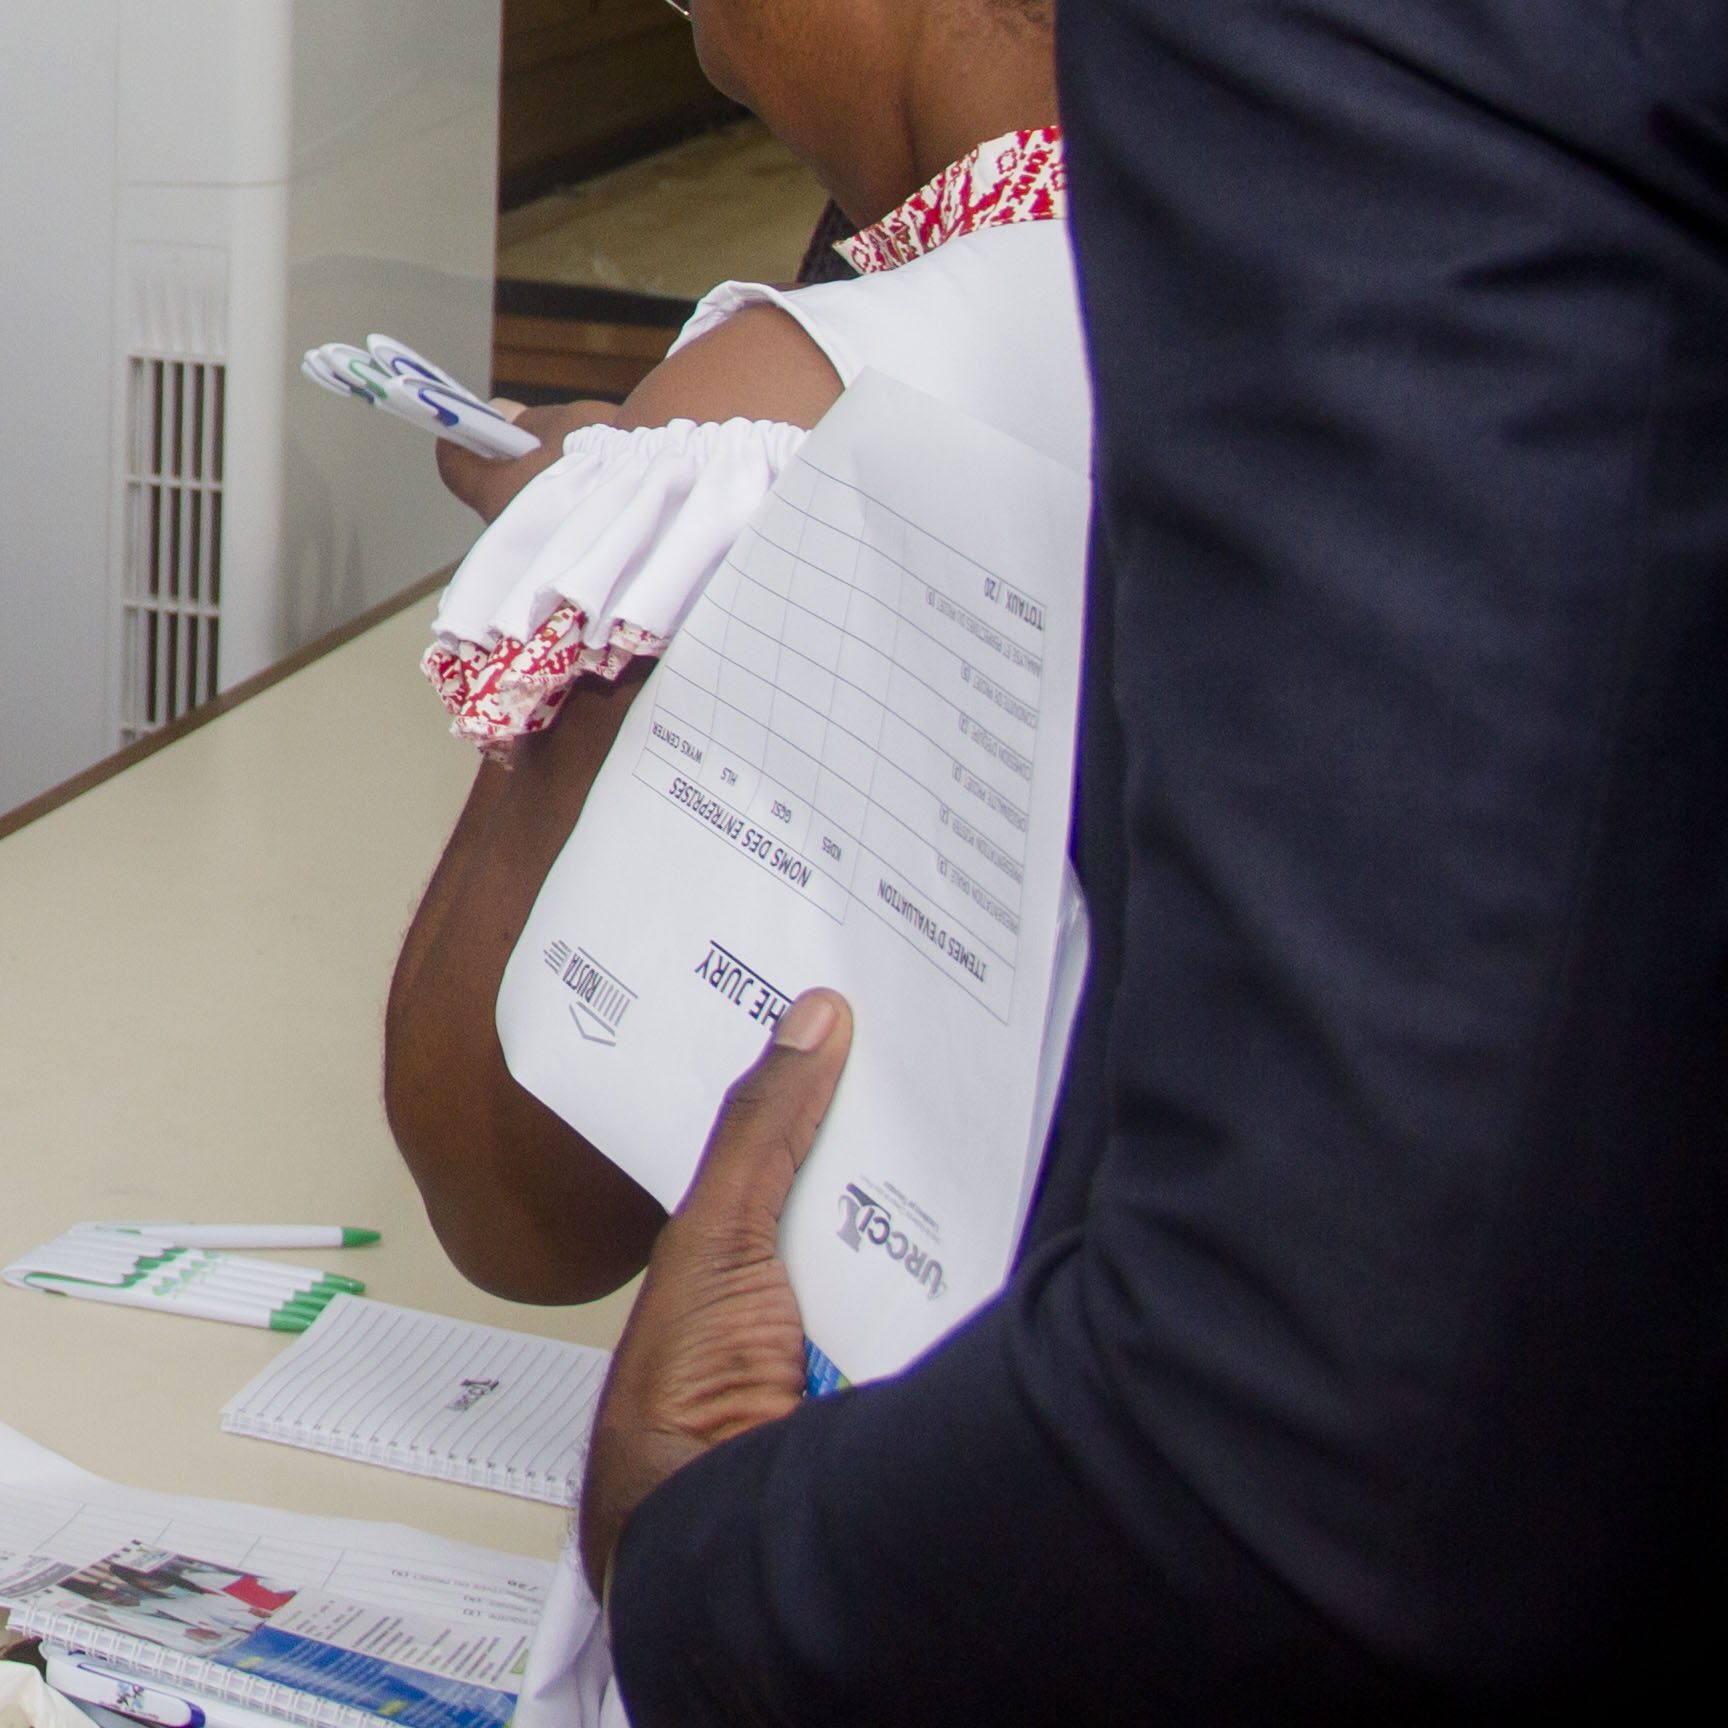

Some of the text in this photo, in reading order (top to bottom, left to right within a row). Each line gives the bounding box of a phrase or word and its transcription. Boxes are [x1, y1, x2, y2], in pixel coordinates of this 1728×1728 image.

[1005, 591, 1043, 631] TOTAUX
[651, 721, 680, 749] CENTER
[720, 766, 738, 786] HLS
[669, 776, 812, 888] NOMS DES ENTREPRISES
[877, 878, 987, 983] ITEMES D'EVALUATION
[562, 951, 605, 1003] RUSTA
[694, 949, 754, 1006] JURY
